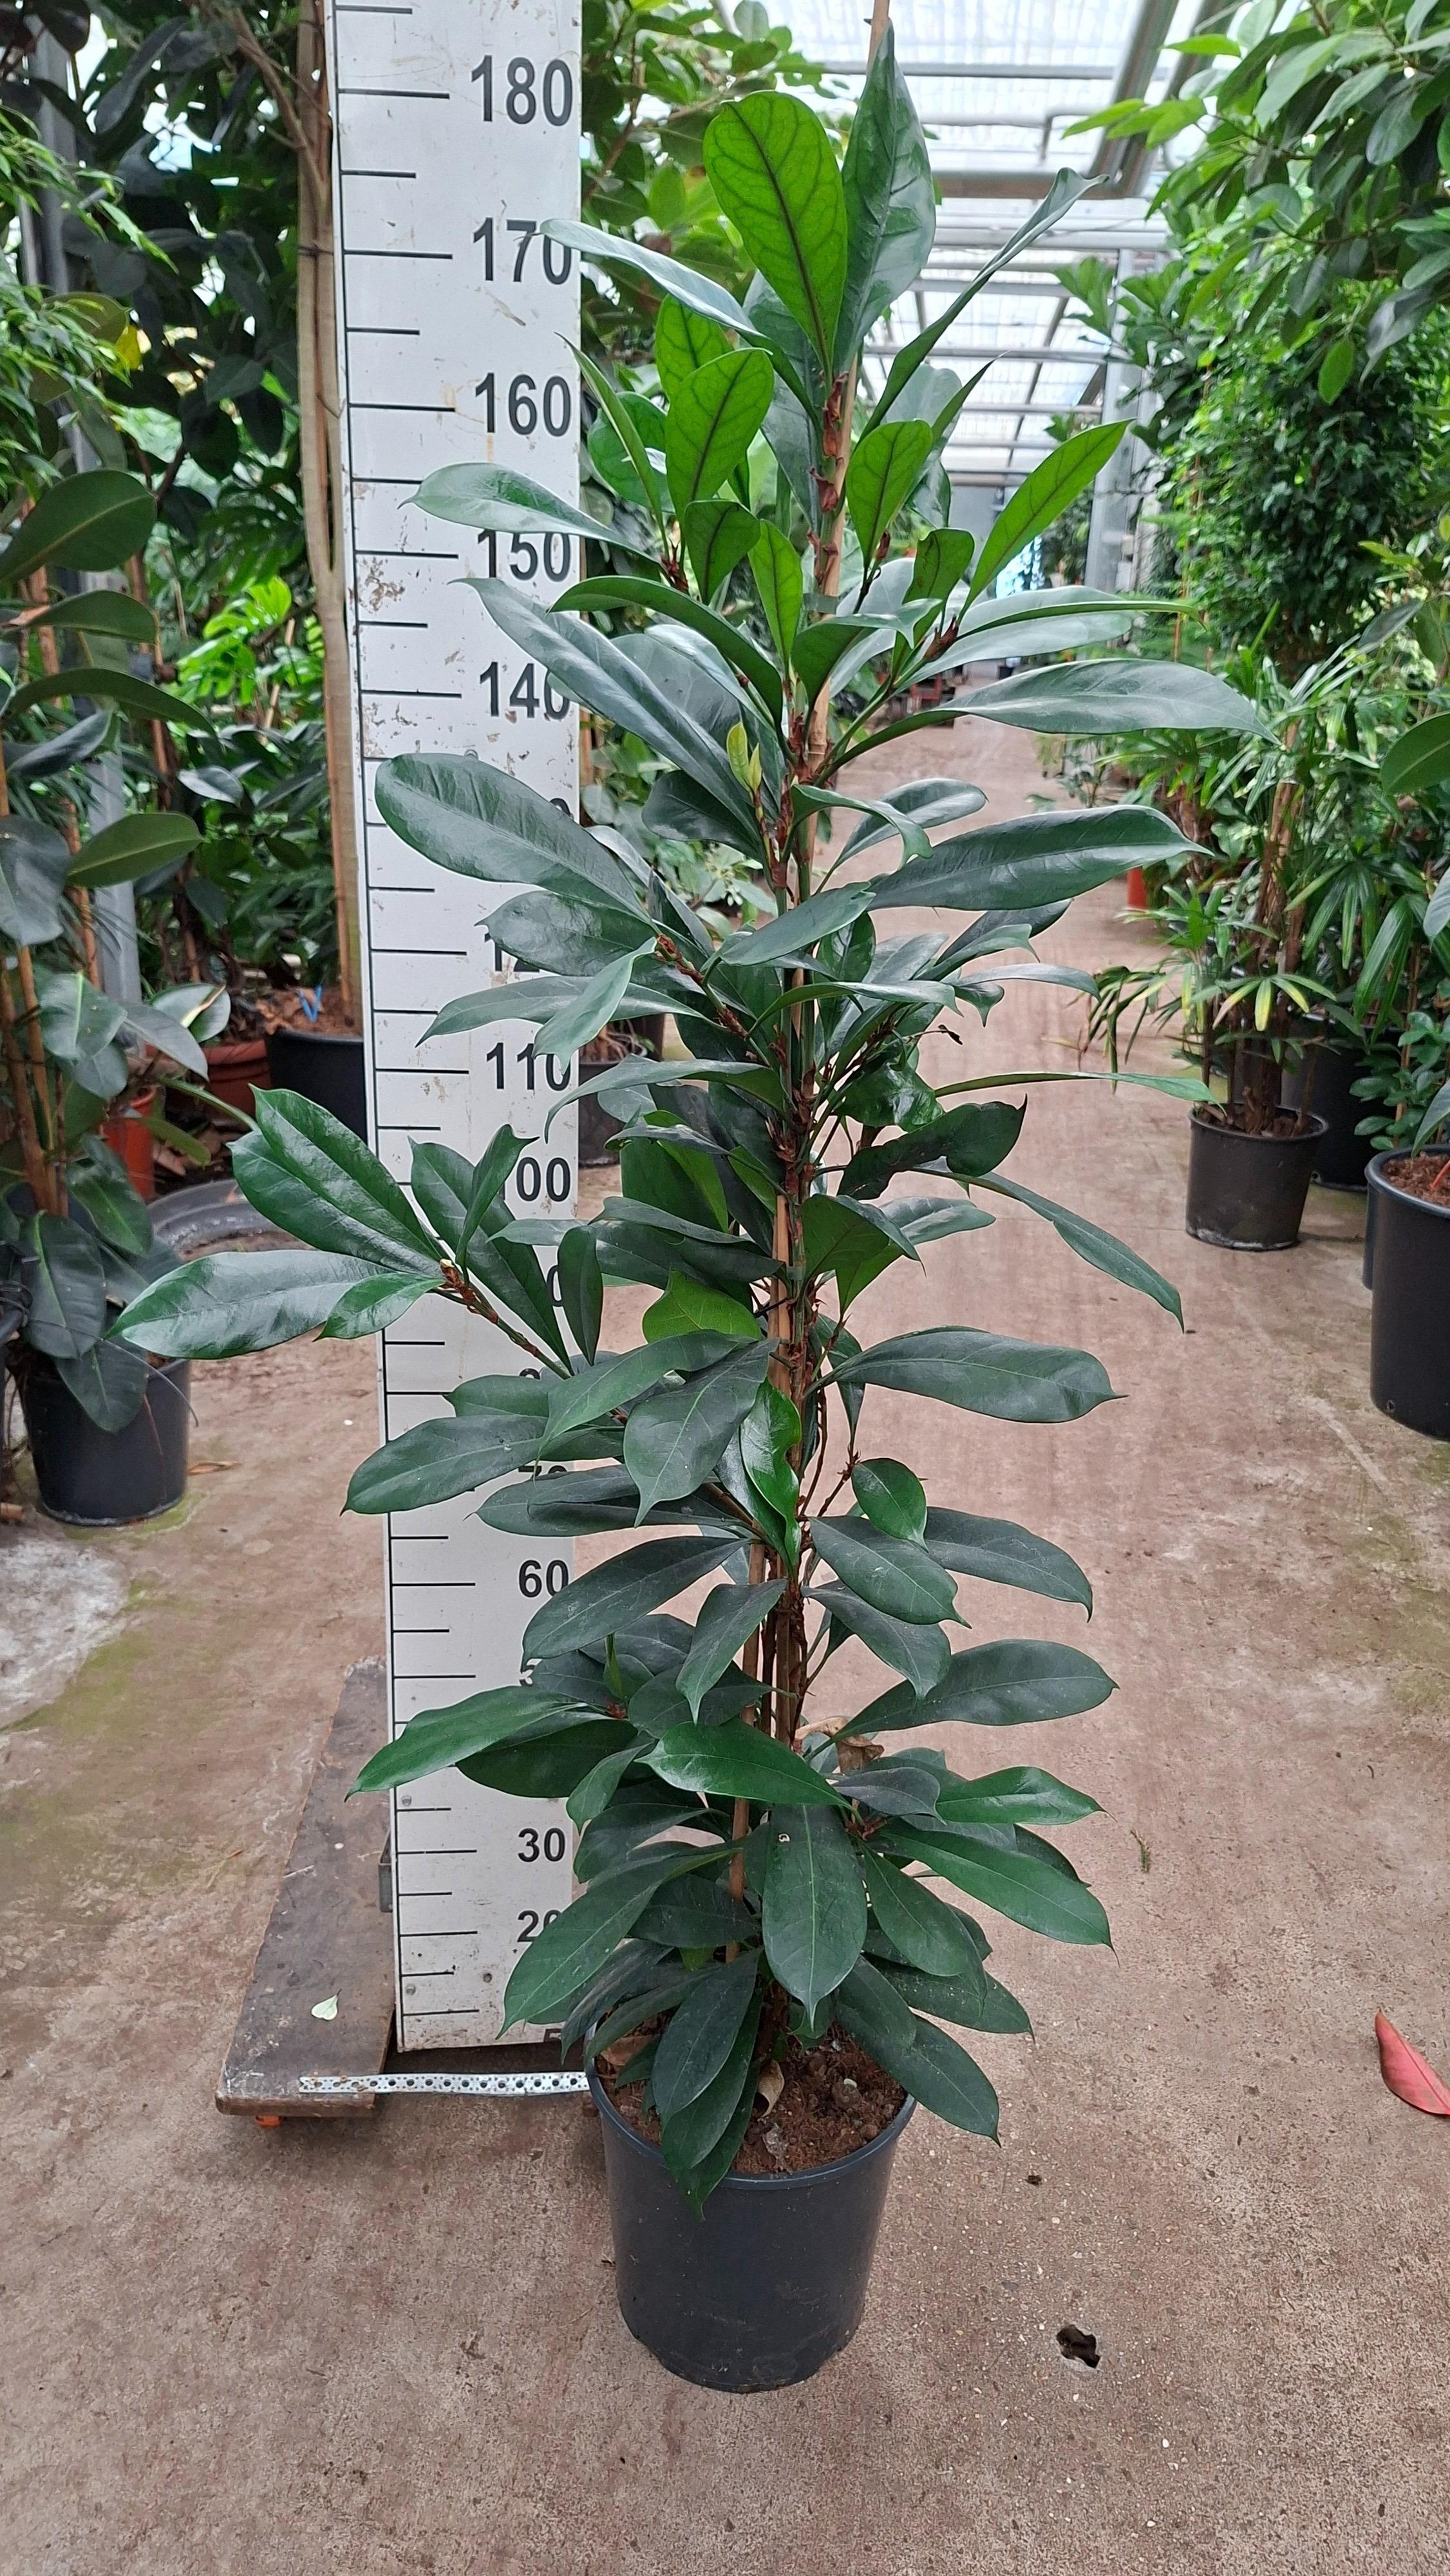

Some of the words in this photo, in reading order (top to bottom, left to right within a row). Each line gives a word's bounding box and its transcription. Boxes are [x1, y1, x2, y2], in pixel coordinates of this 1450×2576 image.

[471, 55, 572, 126] 180
[473, 217, 572, 285] 170
[475, 373, 571, 437] 160
[478, 529, 571, 582] 150
[486, 1042, 571, 1091] 110
[499, 1157, 570, 1202] 00
[519, 1560, 569, 1598] 60
[518, 1828, 565, 1862] 30
